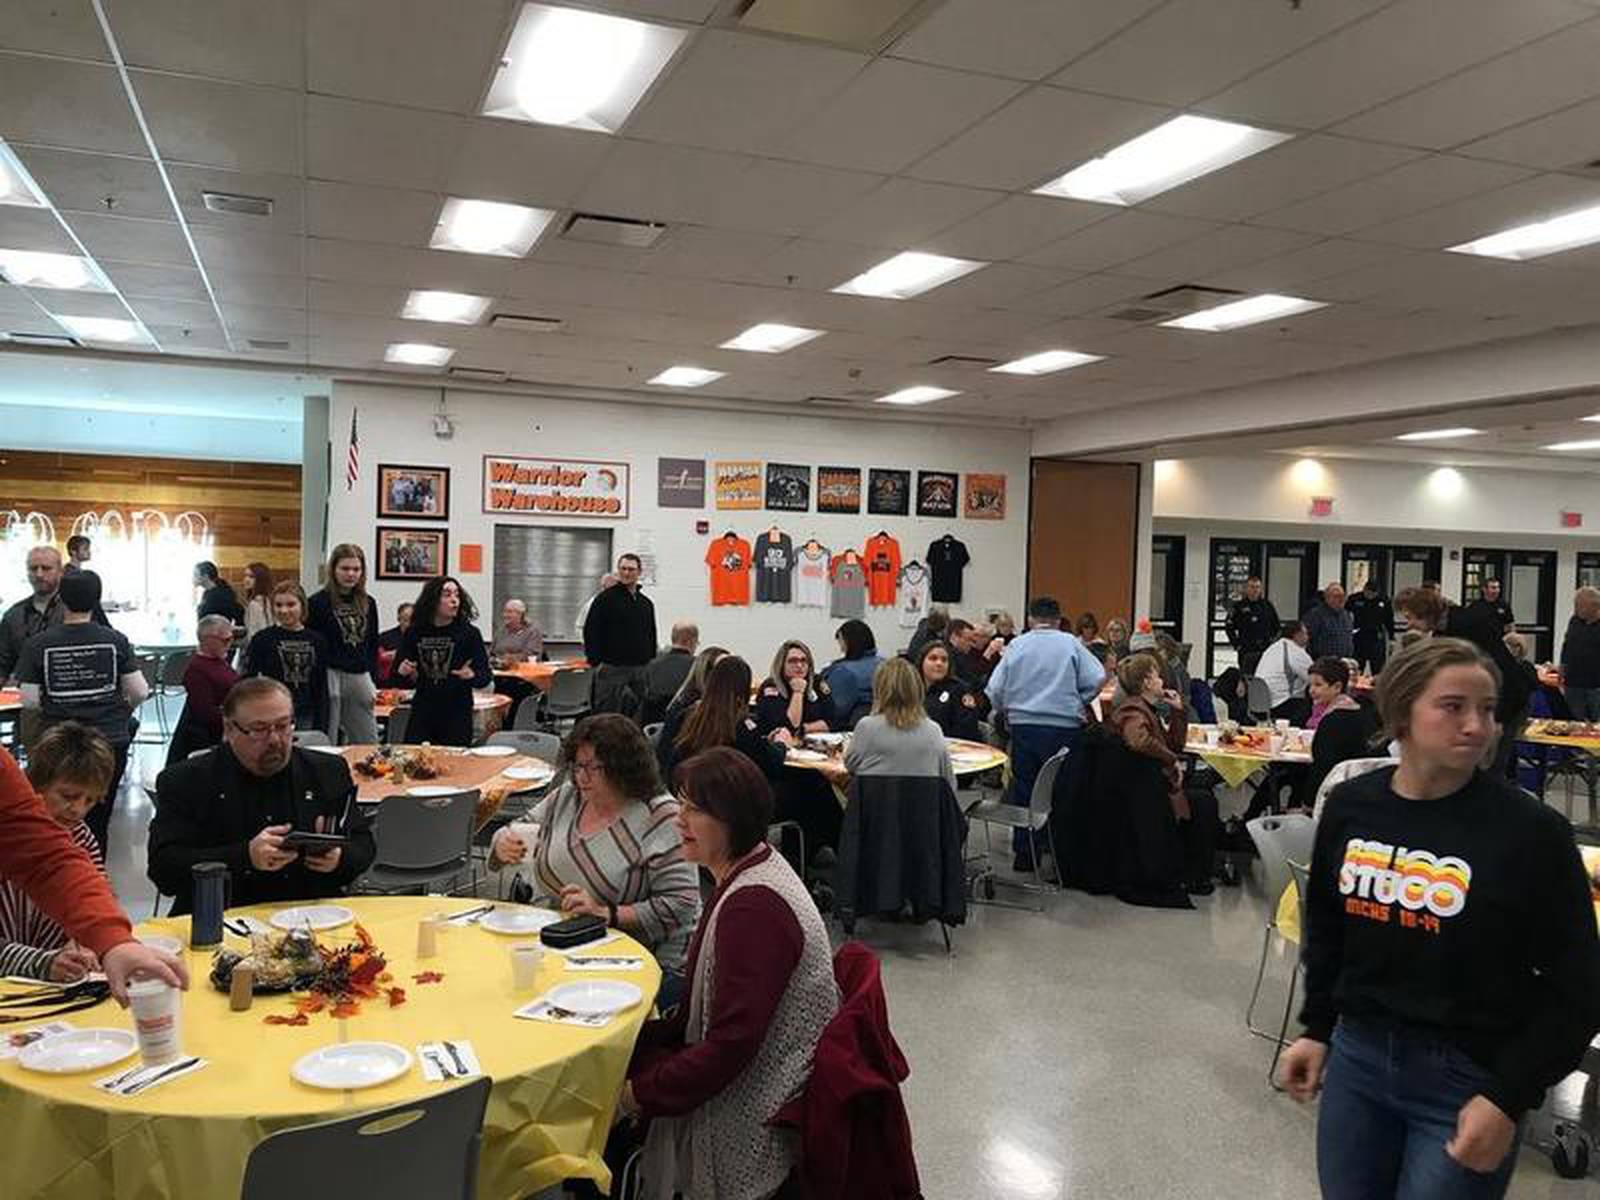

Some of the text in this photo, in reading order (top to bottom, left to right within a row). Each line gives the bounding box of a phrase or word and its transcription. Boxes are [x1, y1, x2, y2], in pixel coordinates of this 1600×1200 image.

[489, 462, 587, 487] Warrior
[490, 487, 621, 514] Warehouse
[1338, 860, 1466, 918] STUCO
